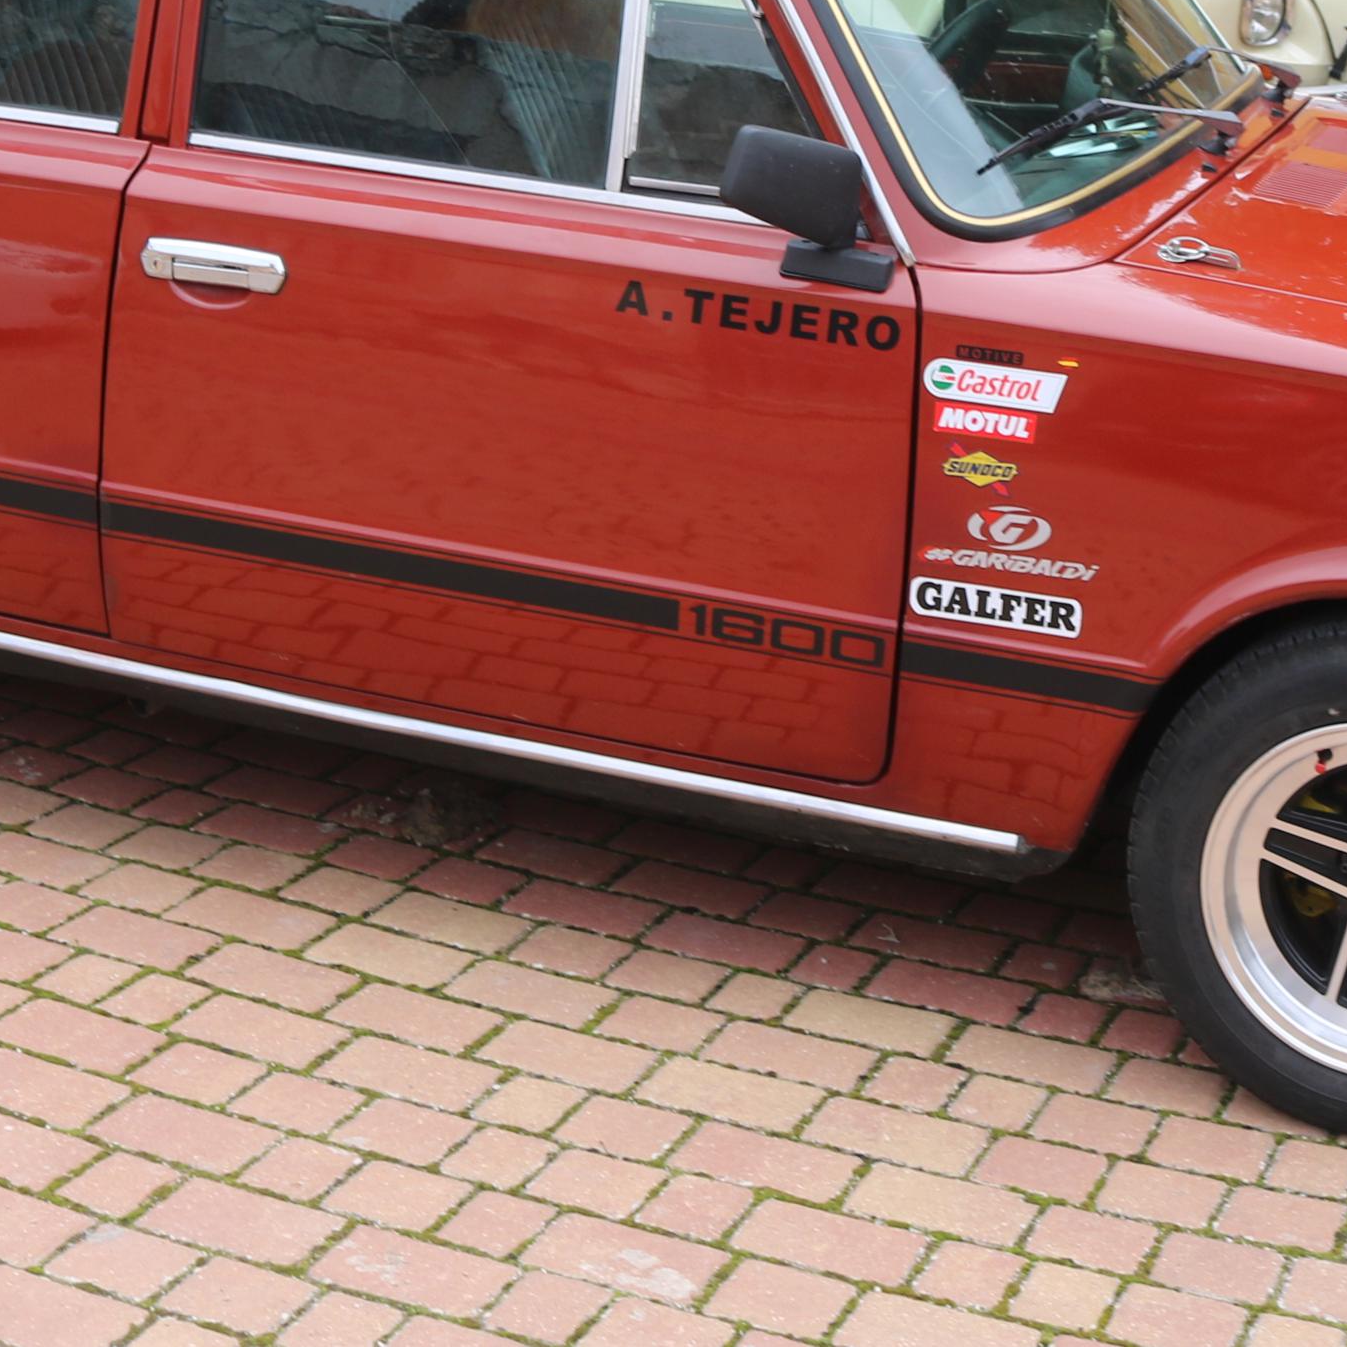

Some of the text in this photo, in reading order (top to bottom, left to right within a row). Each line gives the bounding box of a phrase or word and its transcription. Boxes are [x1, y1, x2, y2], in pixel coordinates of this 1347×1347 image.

[957, 369, 1042, 402] Castrol
[938, 406, 1030, 439] MOTUL
[947, 460, 1014, 478] SUNOCO
[916, 581, 1076, 632] GALFER
[689, 604, 886, 668] 1600
